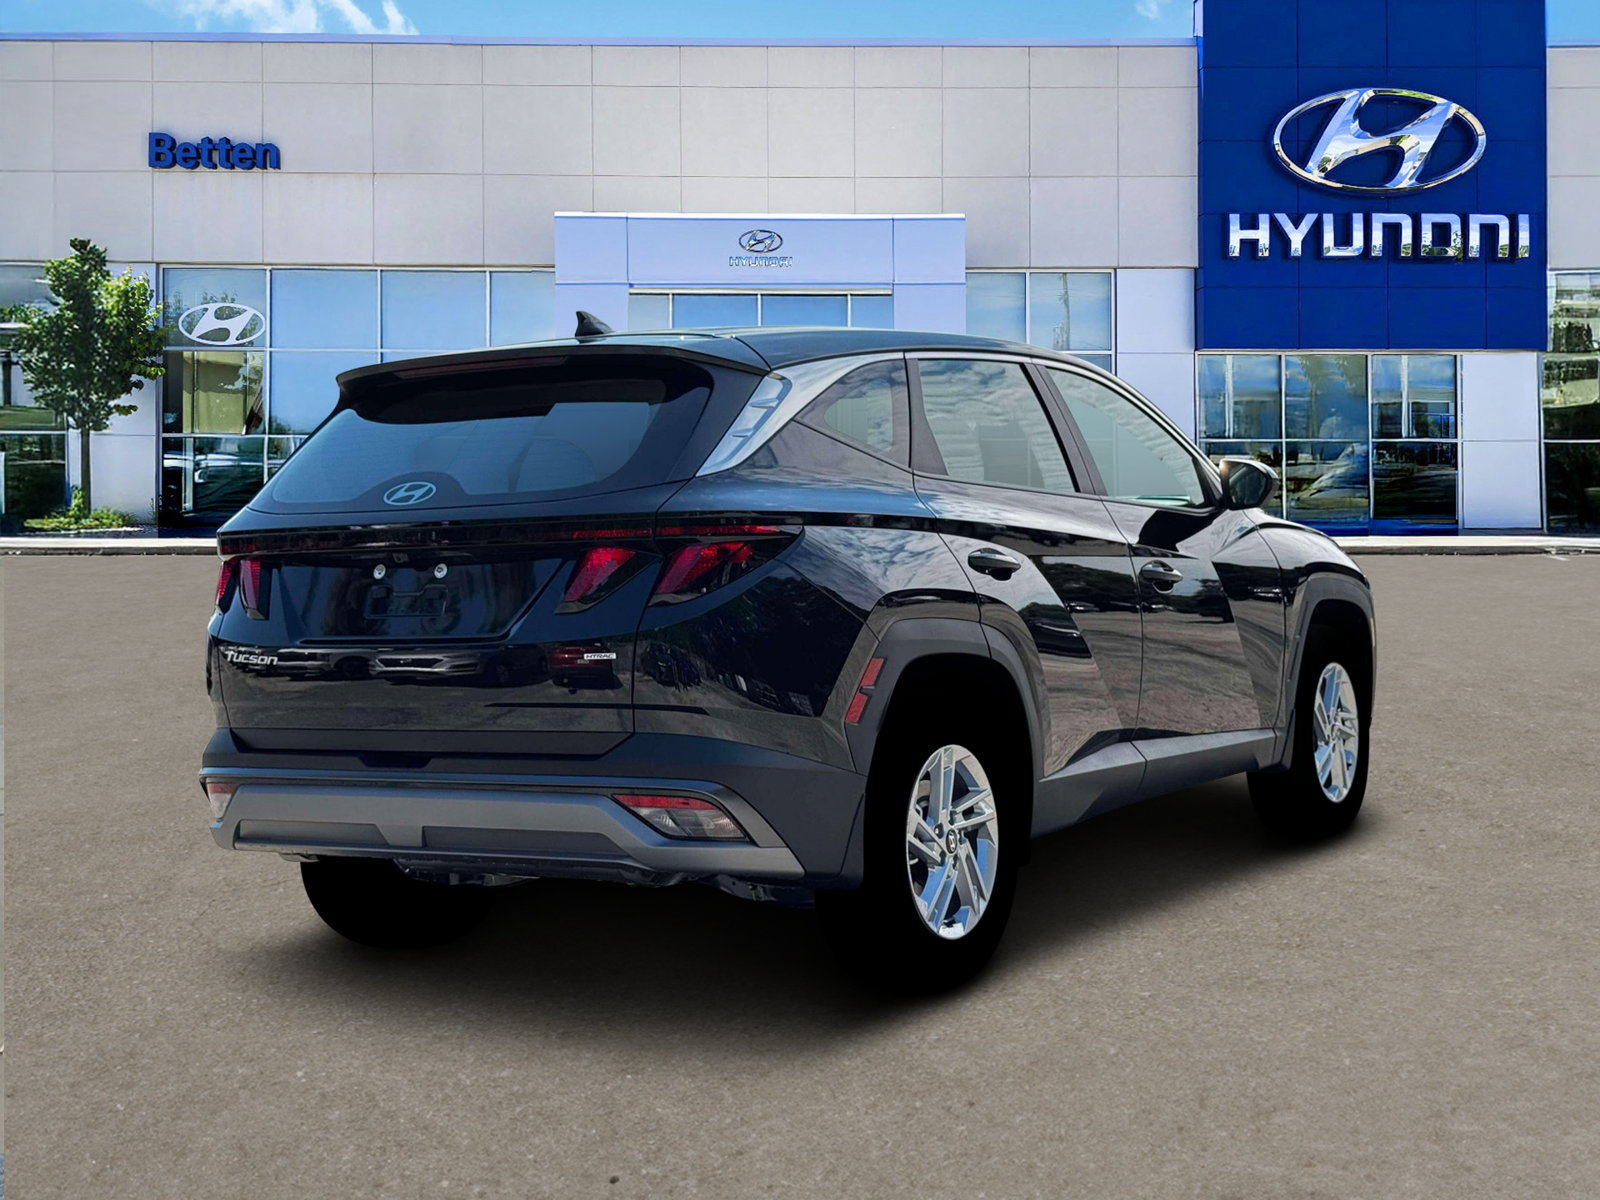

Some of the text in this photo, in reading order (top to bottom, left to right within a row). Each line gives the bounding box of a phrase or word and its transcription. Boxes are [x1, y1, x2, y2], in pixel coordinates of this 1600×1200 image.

[148, 132, 281, 170] Betten
[1228, 212, 1530, 258] HYUNDAI
[728, 256, 793, 267] HYUNDAI
